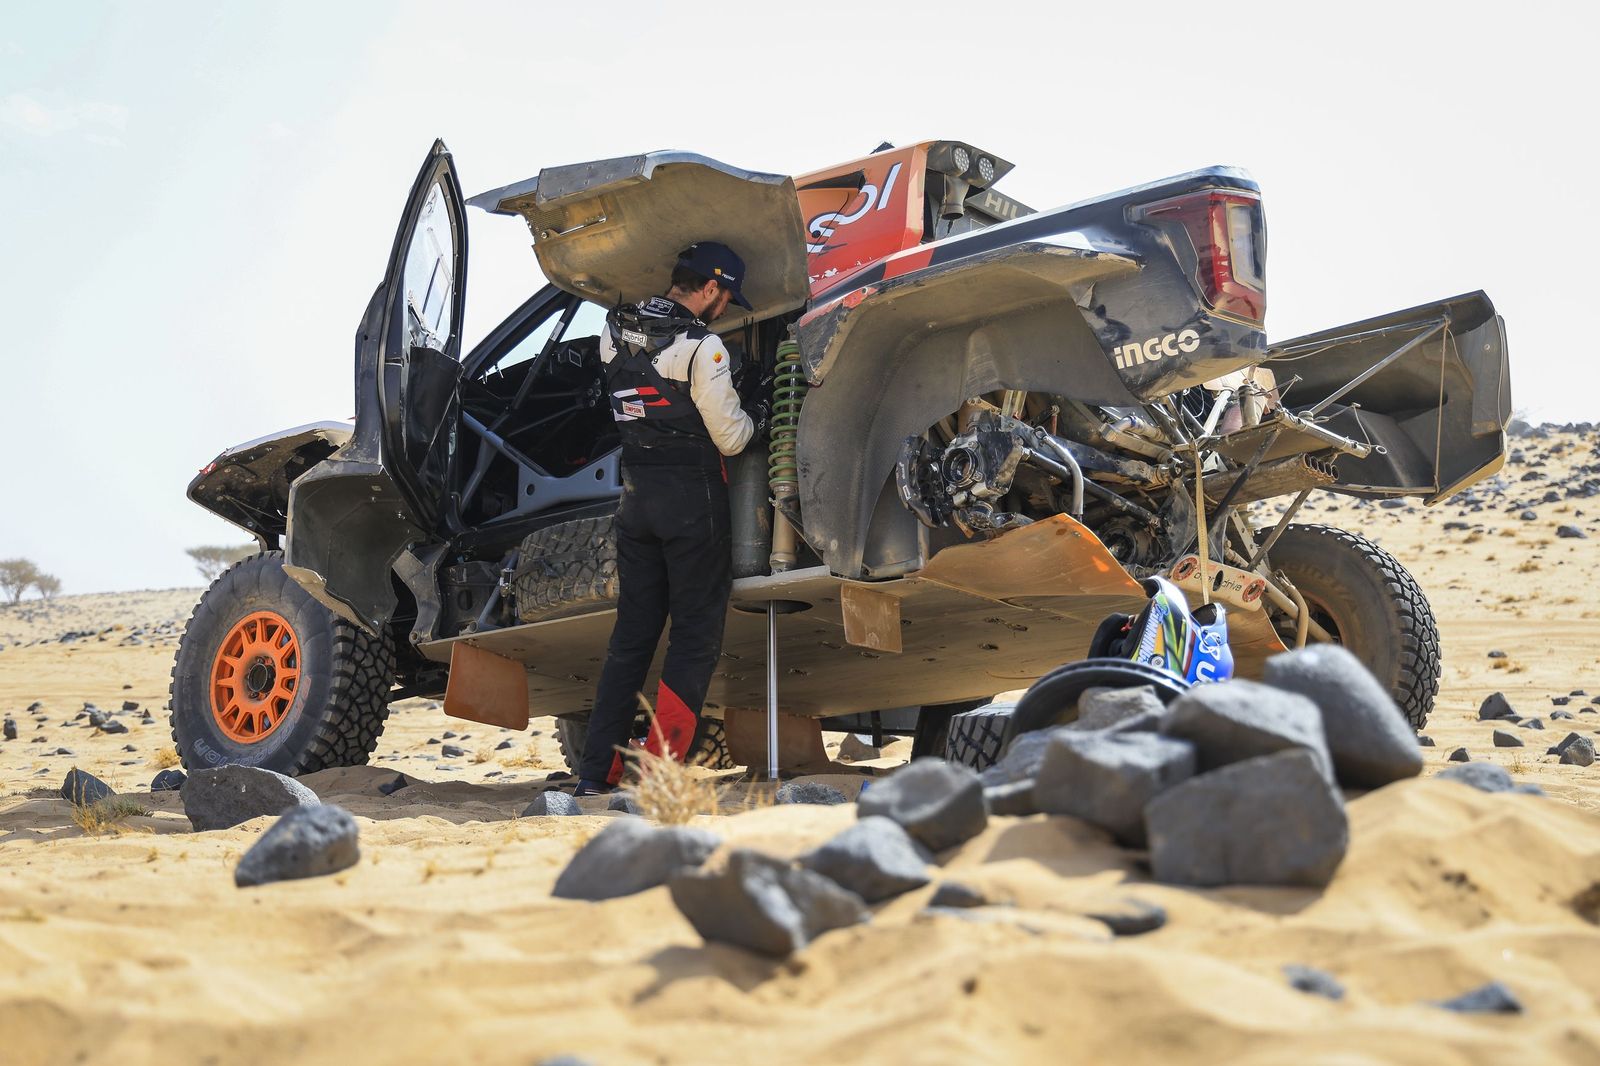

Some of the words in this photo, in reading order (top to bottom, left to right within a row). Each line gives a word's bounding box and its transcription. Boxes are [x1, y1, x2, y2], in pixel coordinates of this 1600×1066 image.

[984, 192, 1033, 219] HIL
[624, 331, 645, 344] Hybrid
[625, 404, 643, 414] SIMPSON
